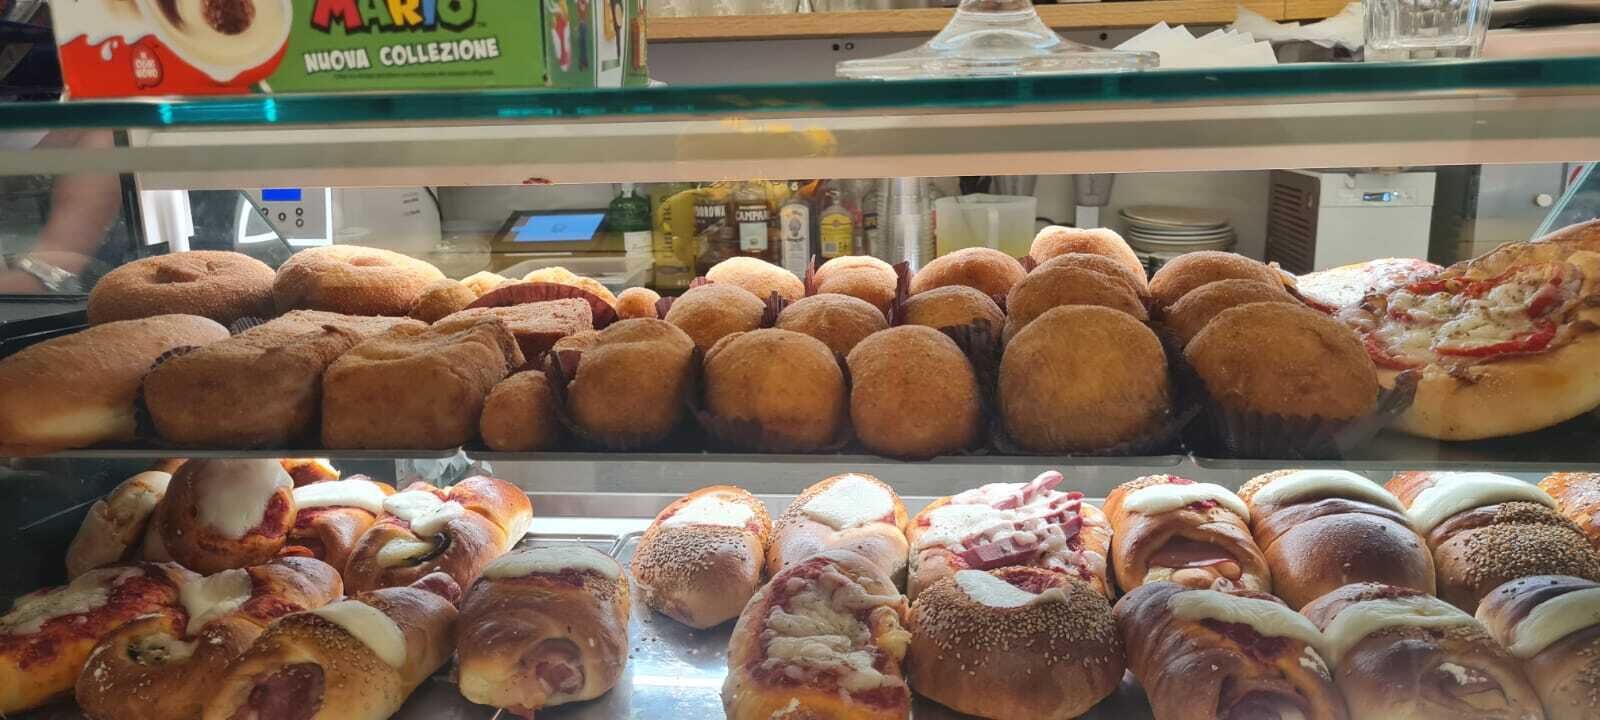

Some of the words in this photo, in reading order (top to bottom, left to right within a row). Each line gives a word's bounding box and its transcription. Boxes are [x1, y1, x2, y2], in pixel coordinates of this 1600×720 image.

[311, 0, 477, 34] MARIO
[304, 49, 370, 73] NUOVA
[380, 38, 499, 66] COLLEZIONE
